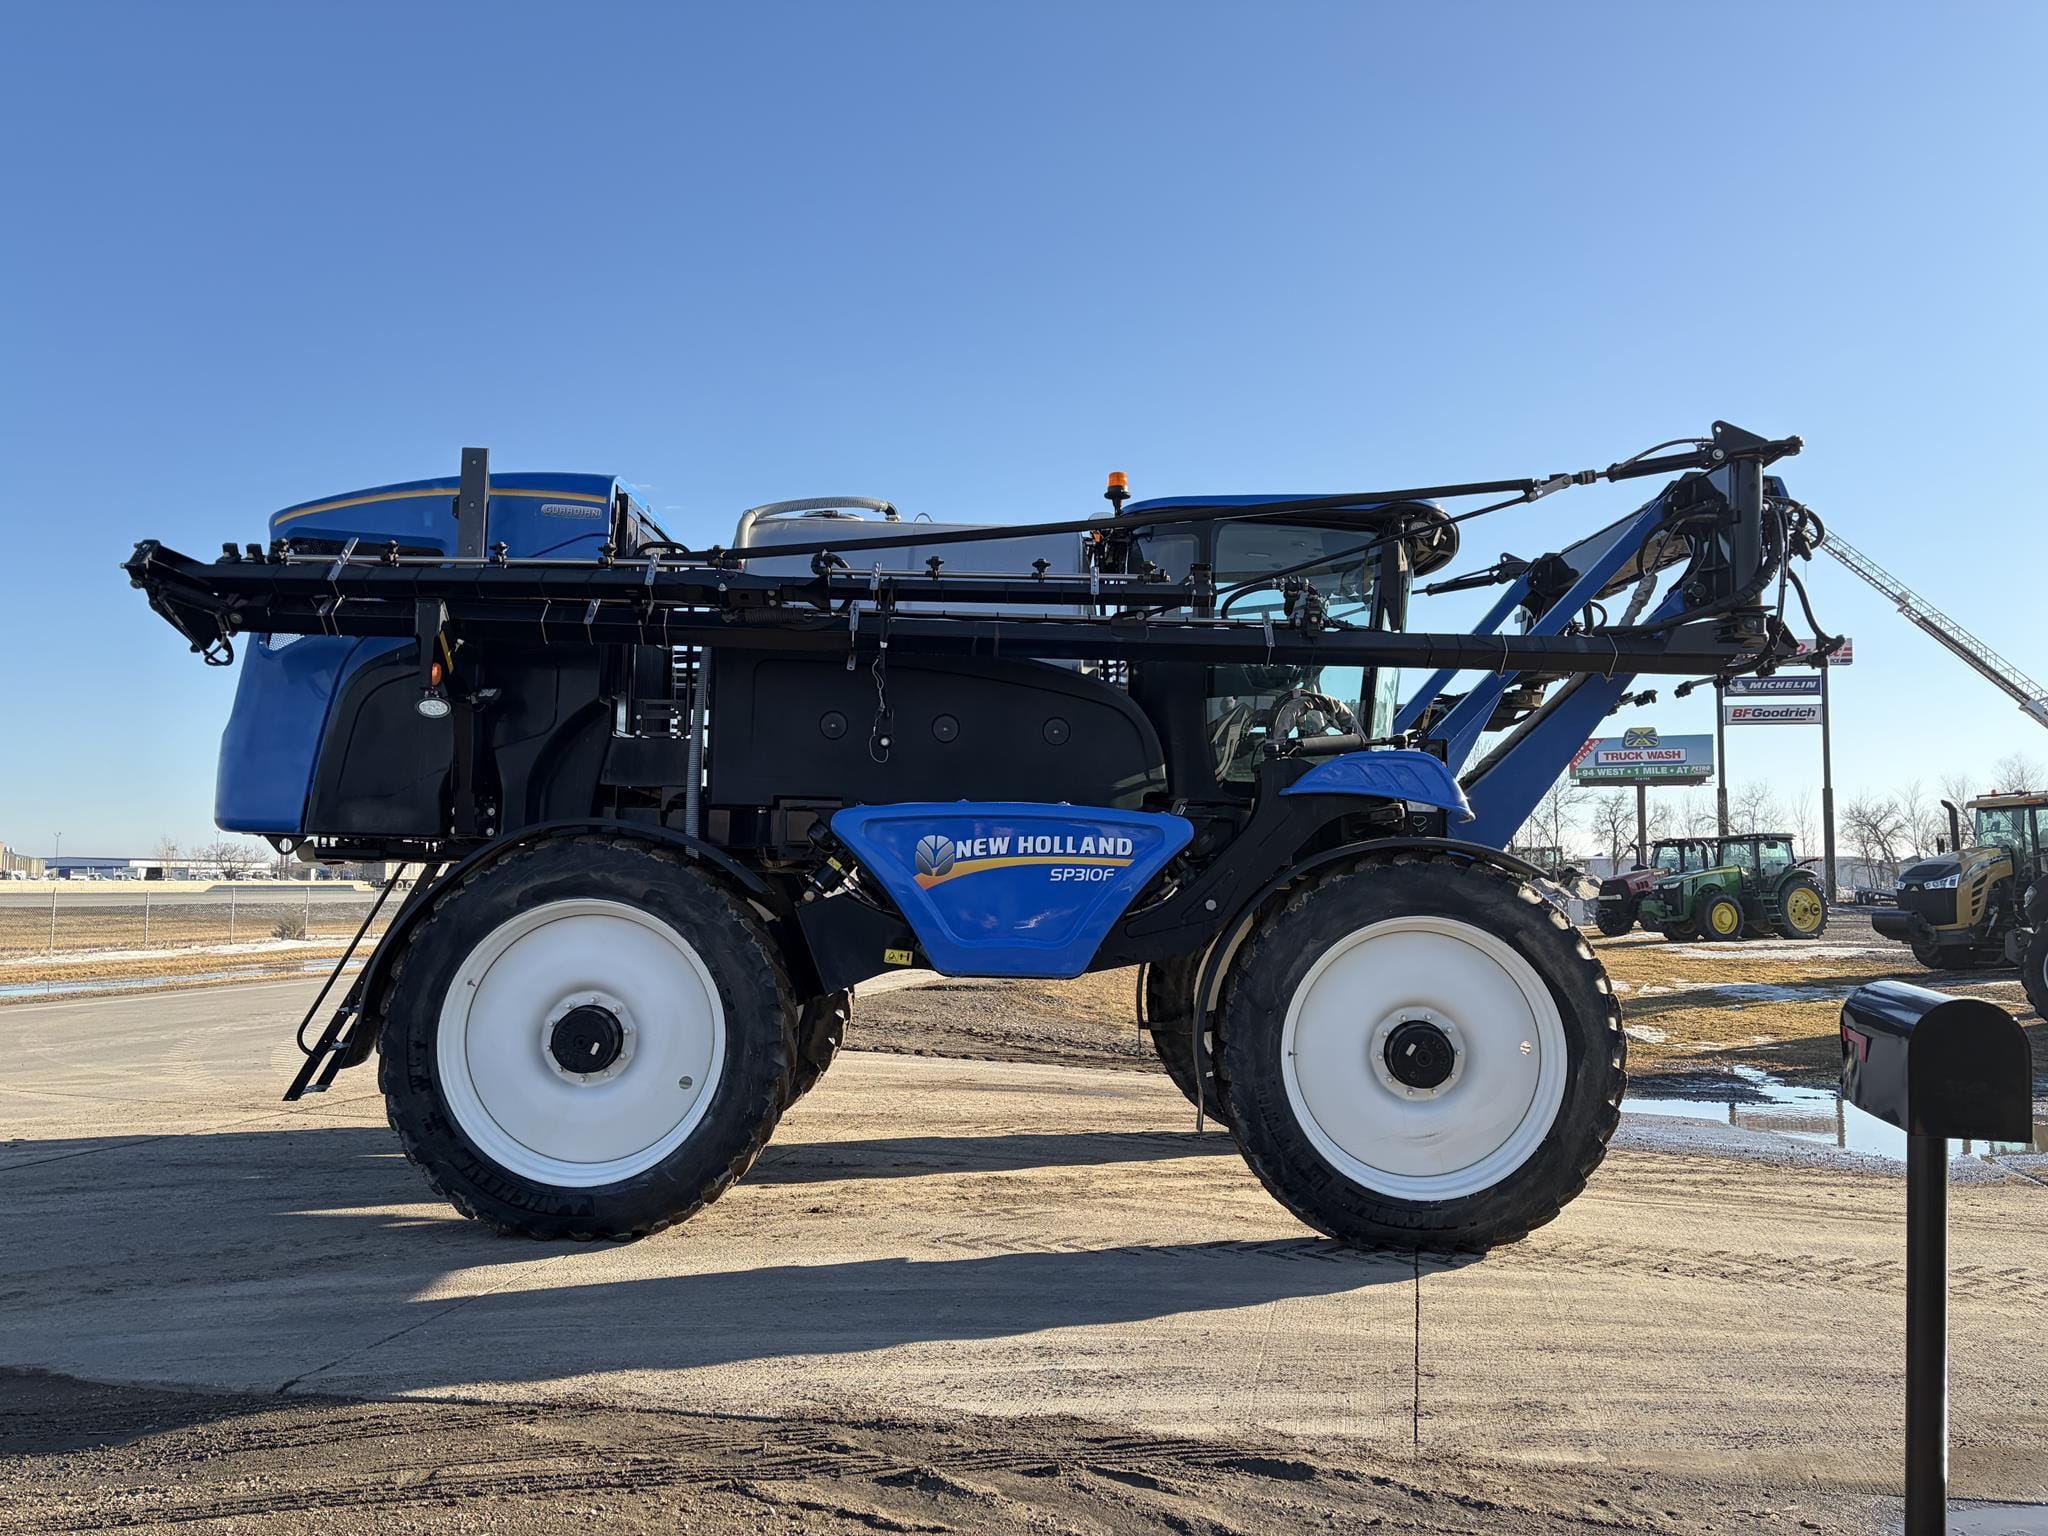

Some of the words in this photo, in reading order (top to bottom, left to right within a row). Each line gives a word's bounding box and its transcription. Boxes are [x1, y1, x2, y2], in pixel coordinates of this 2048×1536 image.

[545, 506, 600, 517] GUARDIAN
[1749, 681, 1817, 689] MICHELIN
[1732, 707, 1816, 718] BFGoodrich
[1603, 751, 1644, 761] TRUCK
[1647, 750, 1681, 760] WASH
[1596, 768, 1625, 776] WEST
[1642, 767, 1668, 775] MILE
[1676, 766, 1689, 774] AT
[955, 836, 1011, 859] NEW
[1017, 835, 1134, 857] HOLLAND
[1049, 868, 1116, 882] SP310F
